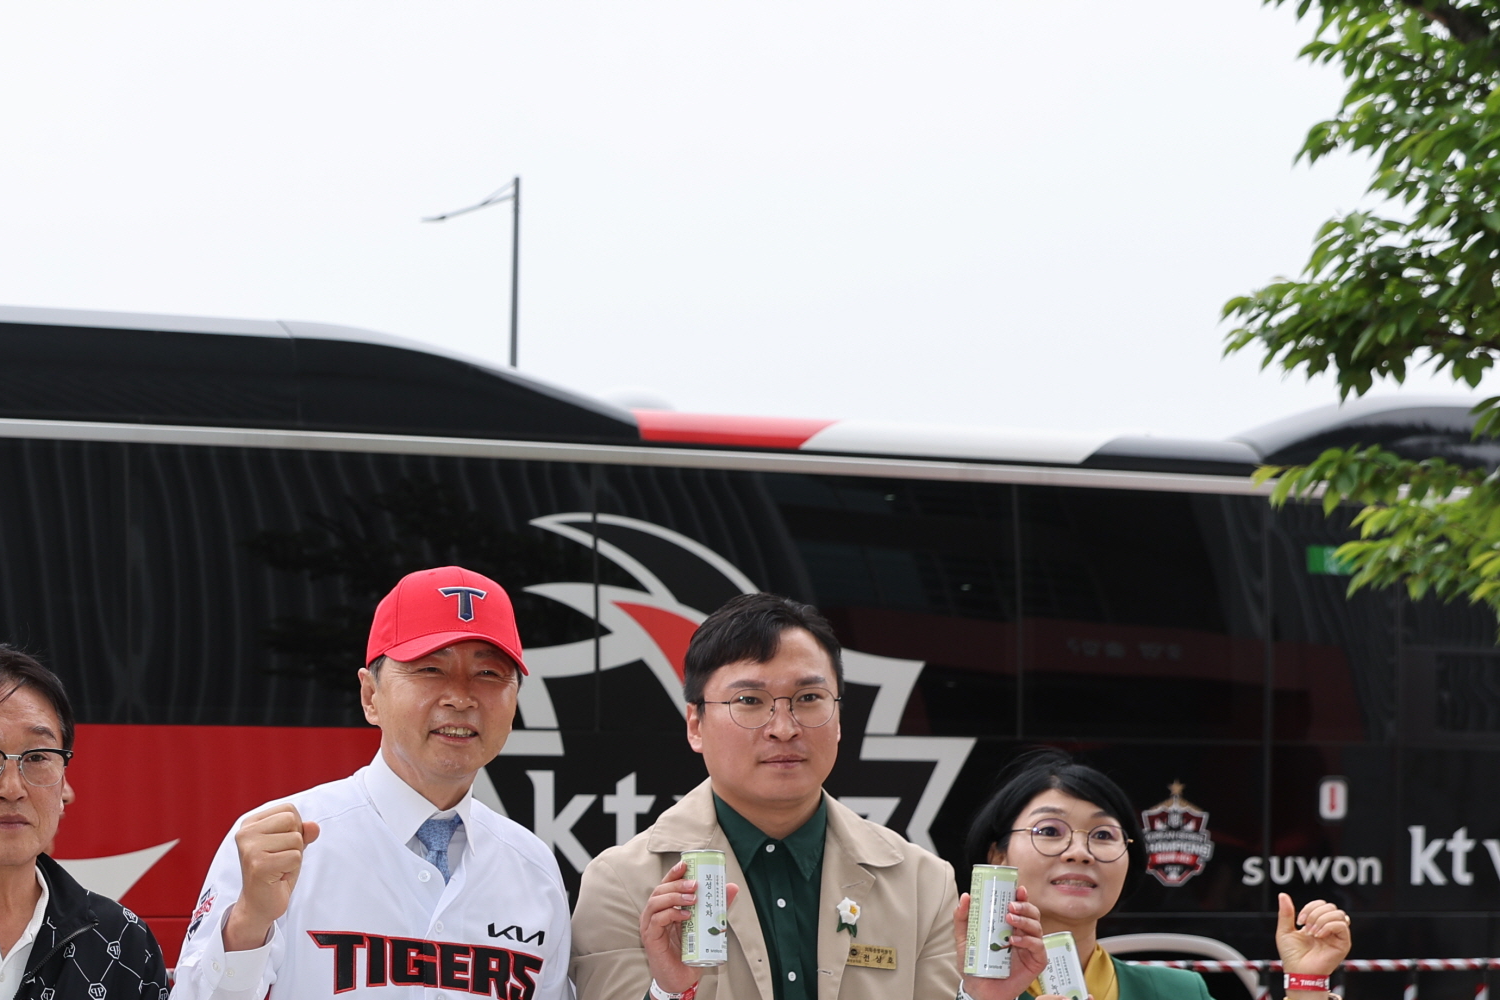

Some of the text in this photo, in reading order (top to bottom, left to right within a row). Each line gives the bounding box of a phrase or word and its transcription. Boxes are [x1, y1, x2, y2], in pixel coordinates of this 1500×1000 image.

[1241, 855, 1383, 886] suwon
[1408, 824, 1476, 887] kt
[487, 922, 545, 947] KIA
